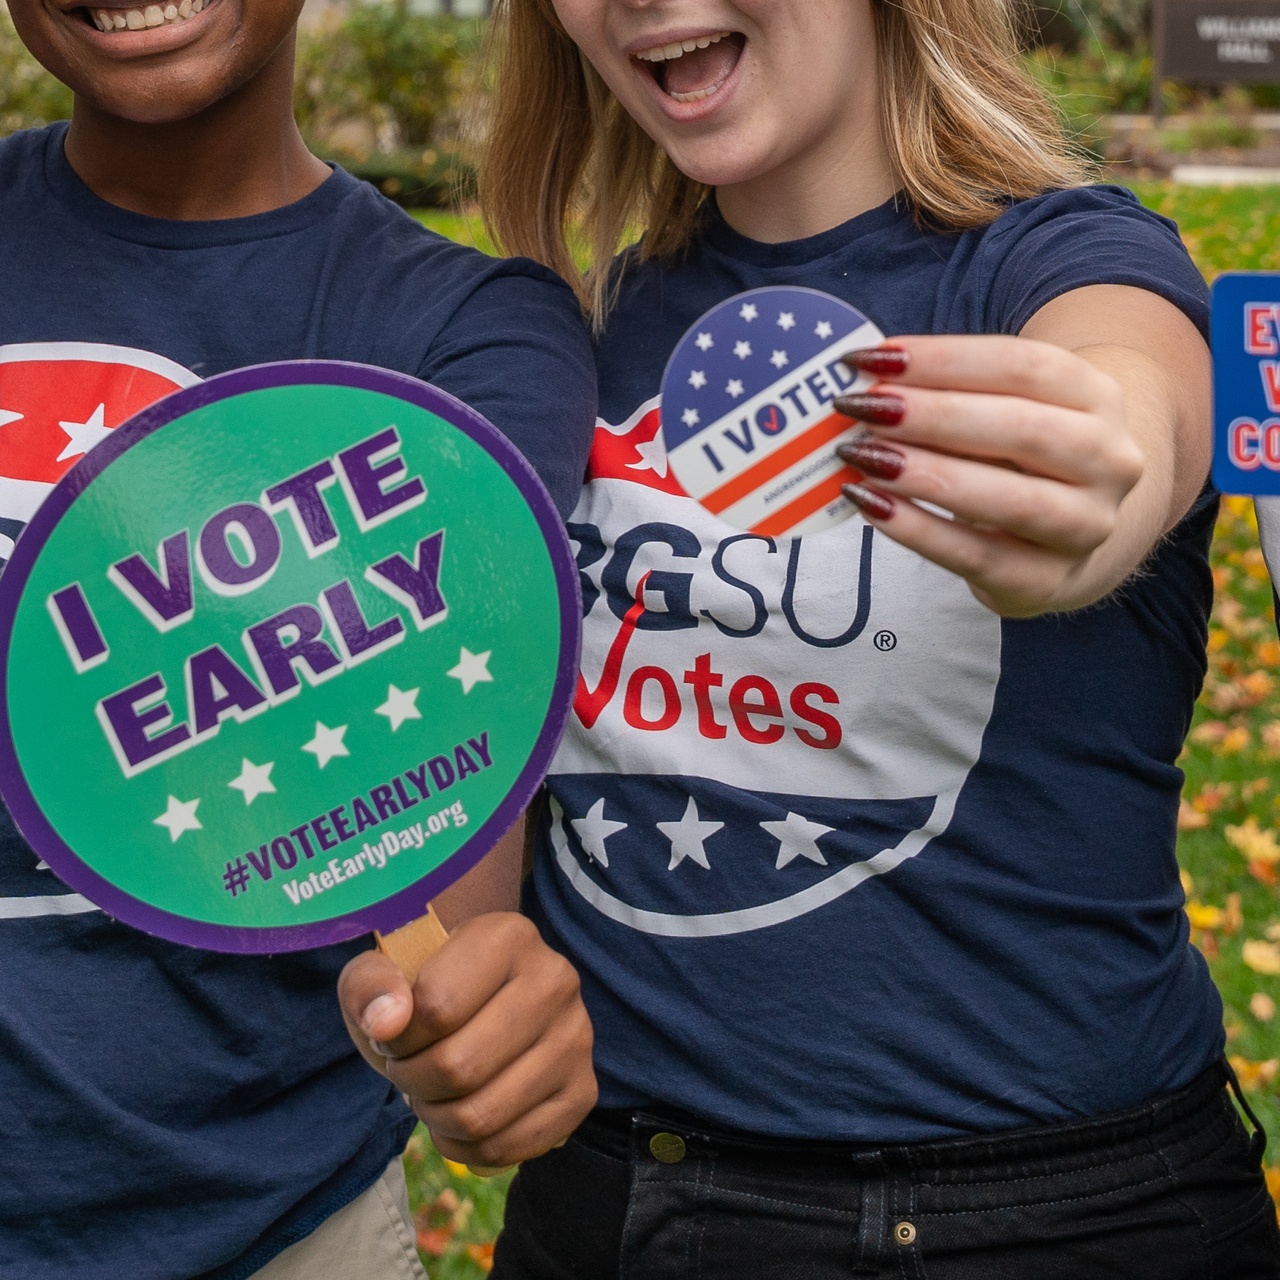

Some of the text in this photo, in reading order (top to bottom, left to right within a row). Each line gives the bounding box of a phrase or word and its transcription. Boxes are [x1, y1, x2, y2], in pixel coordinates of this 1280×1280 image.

[701, 357, 858, 473] I VOTED
[46, 424, 428, 674] I VOTE
[95, 528, 449, 779] EARLY
[573, 569, 843, 750] Votes
[222, 731, 497, 898] #VOTEEARLYDAY
[282, 800, 470, 907] VoteEarlyDay.org
